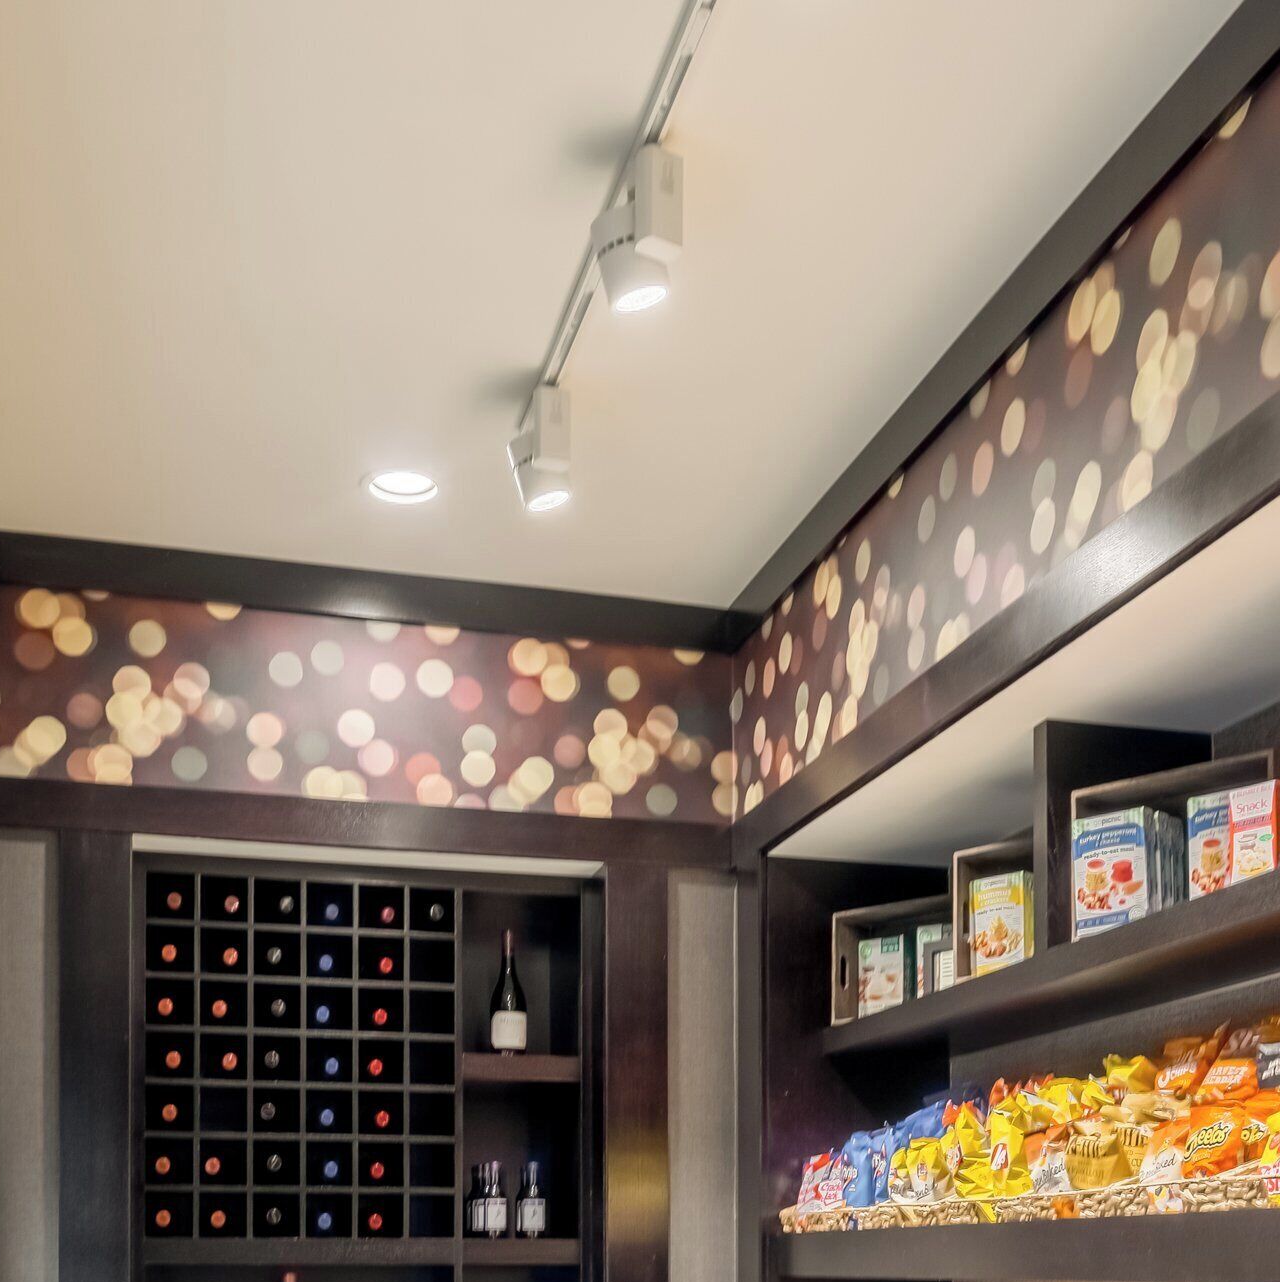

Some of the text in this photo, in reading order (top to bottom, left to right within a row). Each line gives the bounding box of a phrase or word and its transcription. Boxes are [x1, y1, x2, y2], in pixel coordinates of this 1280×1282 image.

[1236, 799, 1269, 814] Snack
[1079, 833, 1100, 845] turkey
[1083, 847, 1119, 861] ready-to-eat
[1184, 1123, 1232, 1161] Cheetos
